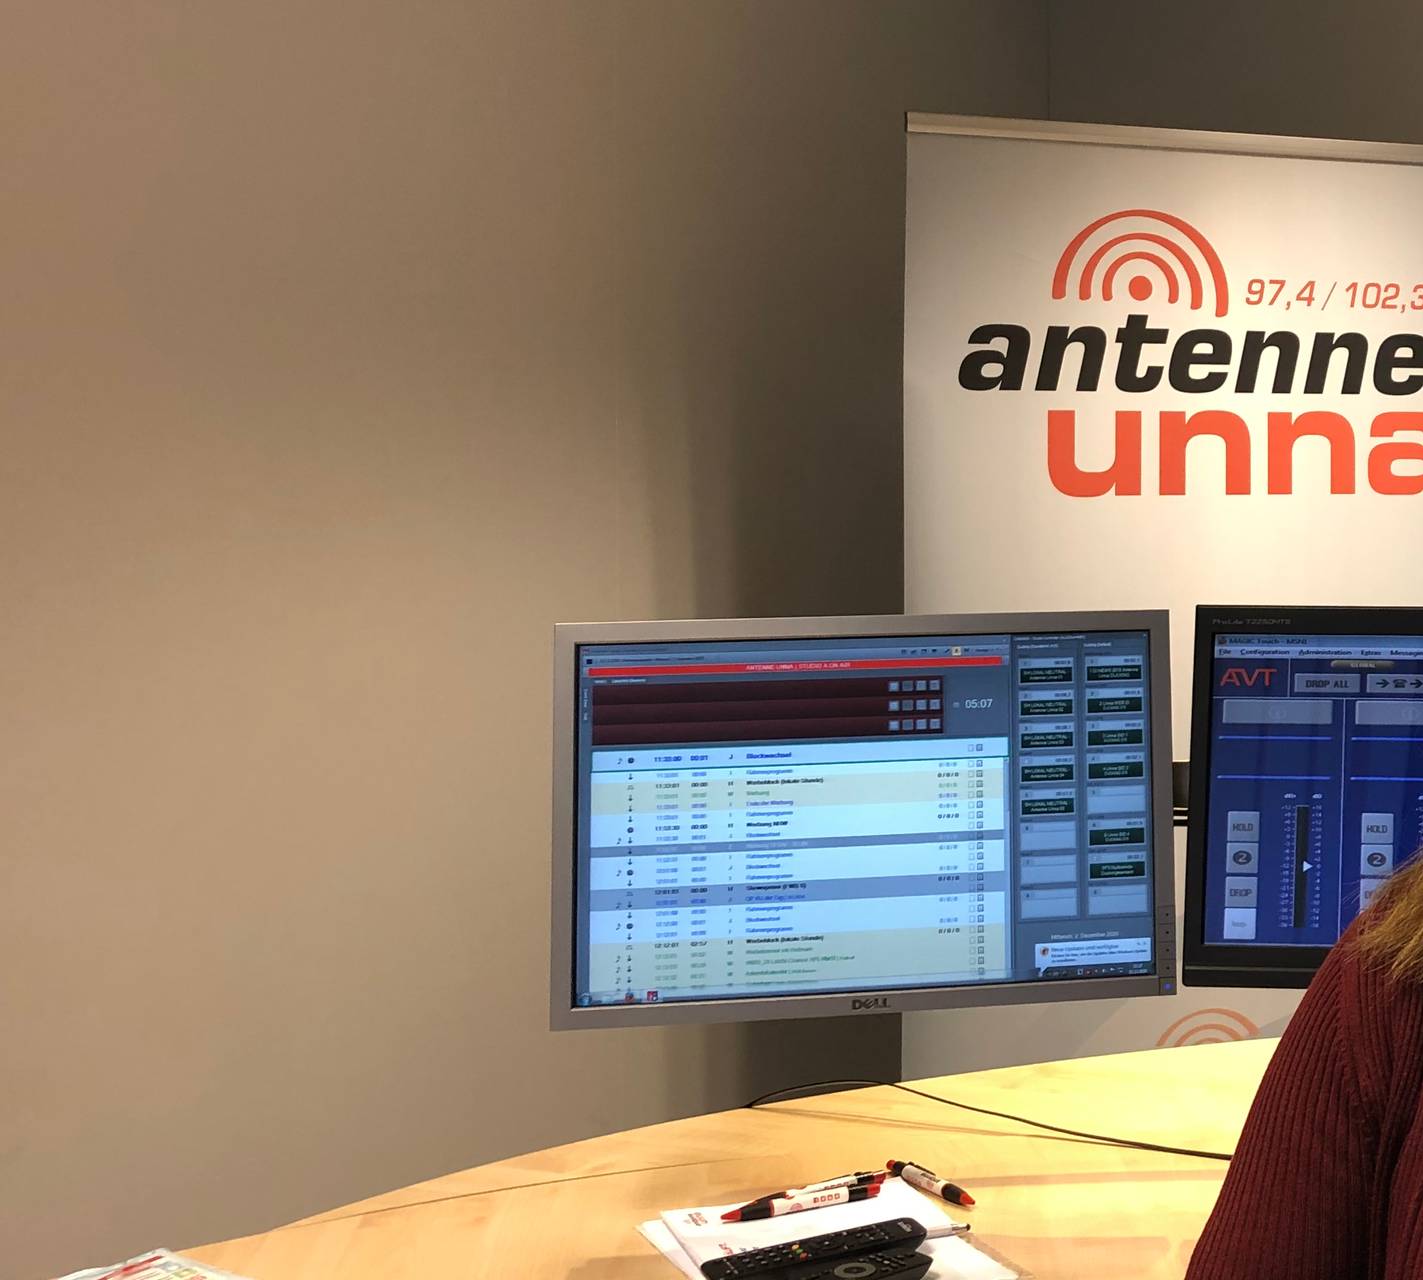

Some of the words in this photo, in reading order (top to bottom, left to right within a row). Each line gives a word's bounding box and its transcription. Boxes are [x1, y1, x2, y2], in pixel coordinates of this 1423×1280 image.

[1245, 279, 1316, 310] 97,4
[1321, 281, 1337, 311] /
[1360, 649, 1381, 657] Extras
[1220, 668, 1277, 687] AVT
[1305, 679, 1330, 688] DROP
[1333, 680, 1350, 688] ALL
[965, 698, 993, 709] 05:07
[1232, 822, 1254, 833] HOLD
[1366, 824, 1388, 834] HOLD
[1237, 852, 1248, 863] 2
[1371, 854, 1382, 865] 2
[1229, 888, 1253, 898] DROP
[852, 998, 891, 1010] DELL
